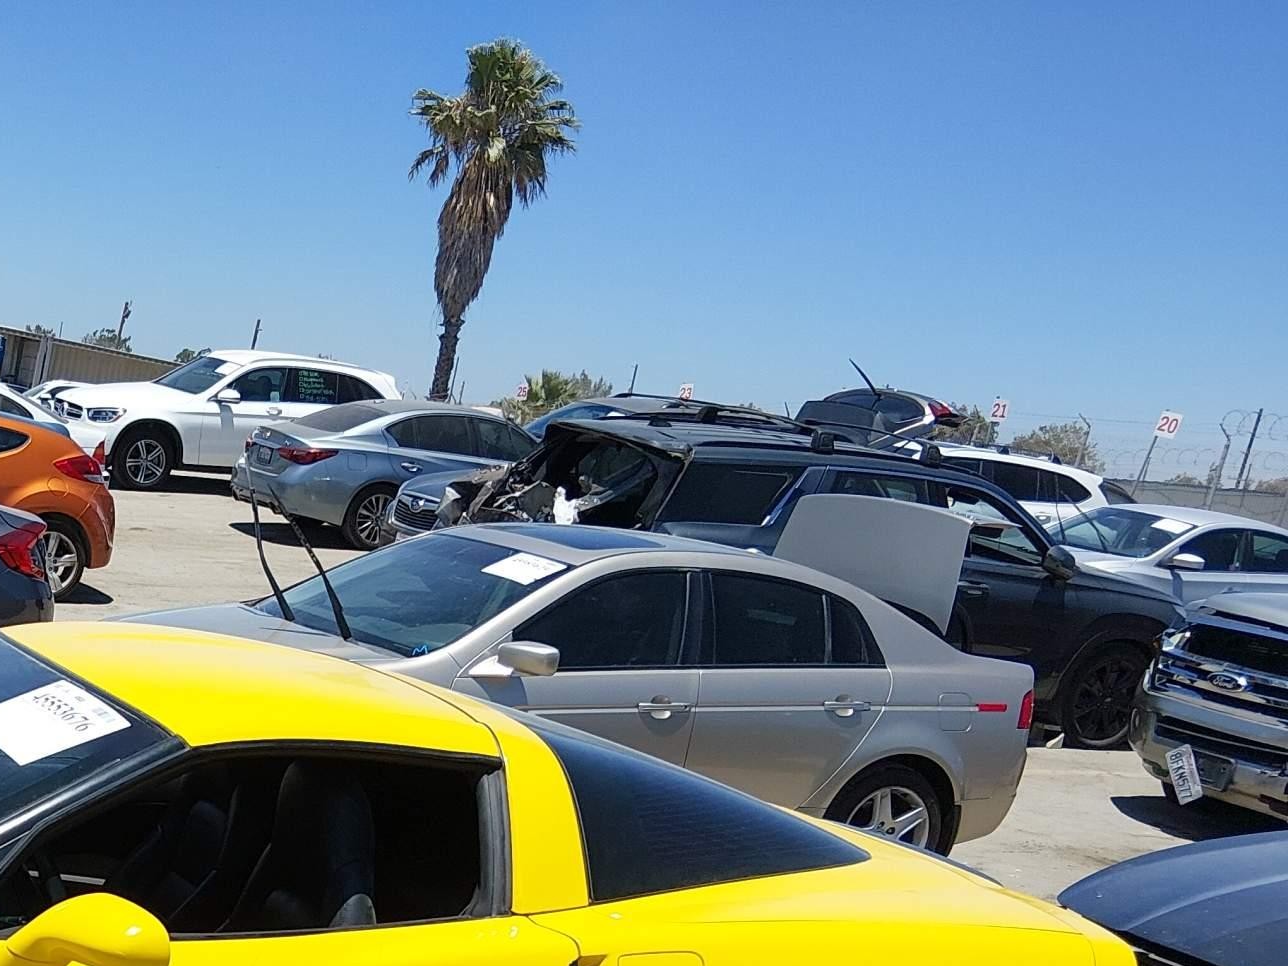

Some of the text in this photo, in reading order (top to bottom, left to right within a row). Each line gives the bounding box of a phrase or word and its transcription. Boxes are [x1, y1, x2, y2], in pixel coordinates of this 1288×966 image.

[517, 386, 527, 397] 25
[680, 387, 692, 399] 23
[991, 402, 1007, 418] 21
[1157, 416, 1179, 433] 20
[1212, 675, 1238, 689] Ford
[33, 693, 97, 732] 45553676
[1169, 750, 1193, 799] 8FKN577
